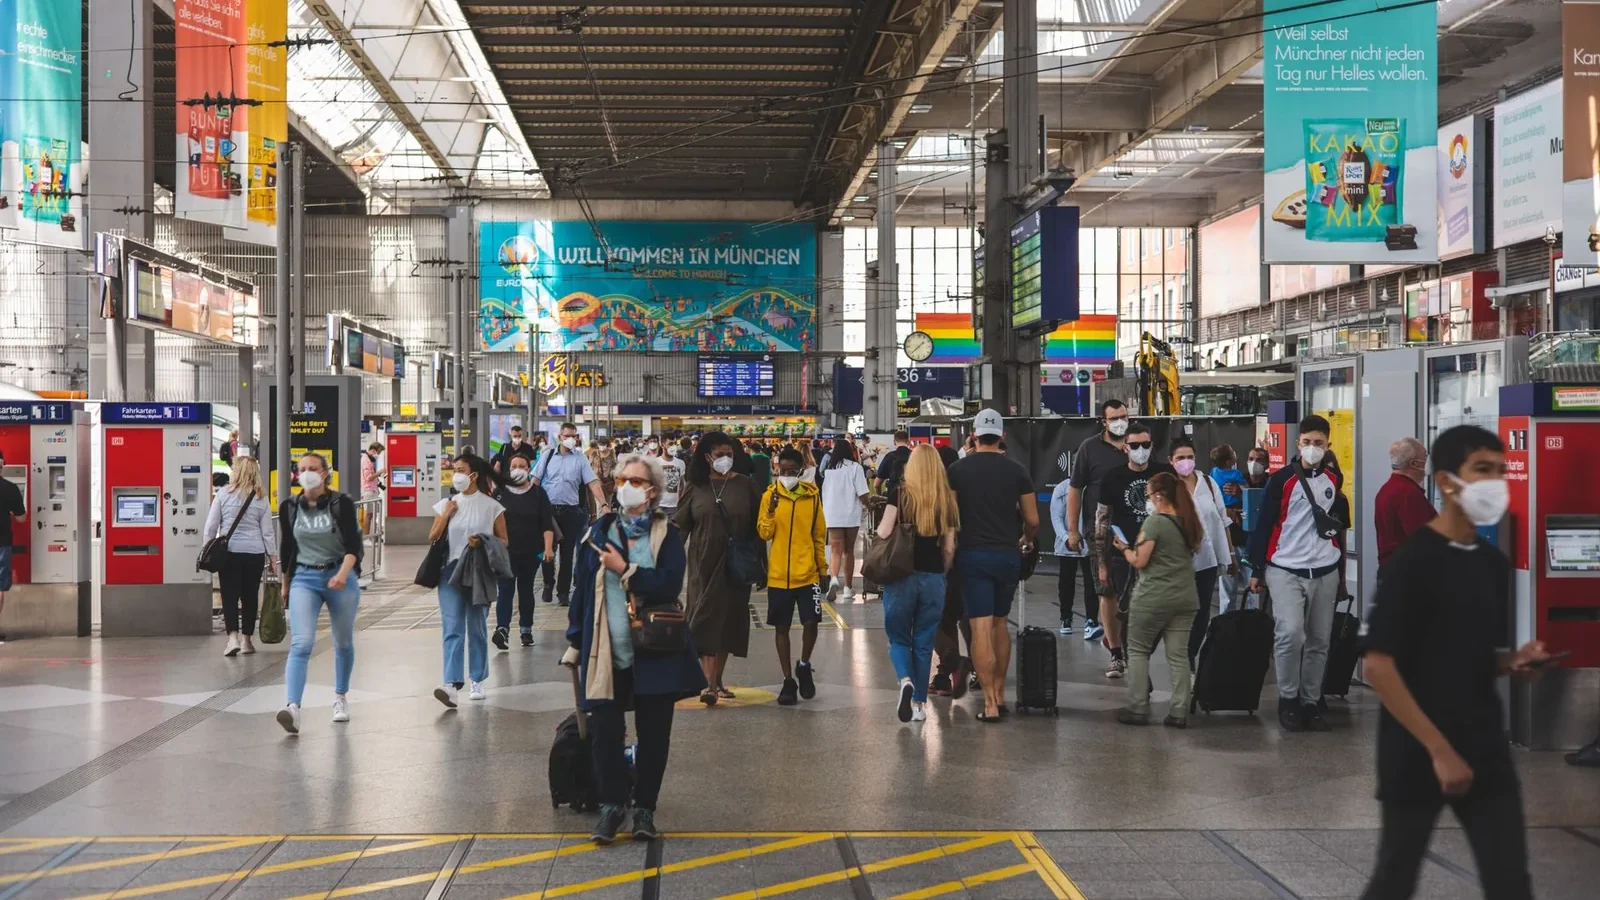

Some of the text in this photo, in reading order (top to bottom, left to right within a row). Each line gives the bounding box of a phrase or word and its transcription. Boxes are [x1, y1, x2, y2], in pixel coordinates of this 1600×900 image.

[1273, 23, 1349, 41] Weil selbst
[1275, 43, 1425, 66] Münchner nicht jeden
[1274, 63, 1428, 86] Tag nur Helles wollen.
[190, 111, 230, 135] BUNTE
[1309, 133, 1399, 153] KAKAO
[191, 163, 228, 189] TÜTE
[1345, 185, 1364, 195] mini
[1325, 203, 1382, 228] MIX
[558, 244, 800, 265] WILLKOMMEN IN MÜNCHEN
[1556, 267, 1582, 282] CHANGE
[1547, 438, 1561, 447] DB
[1129, 478, 1150, 487] VERSAC
